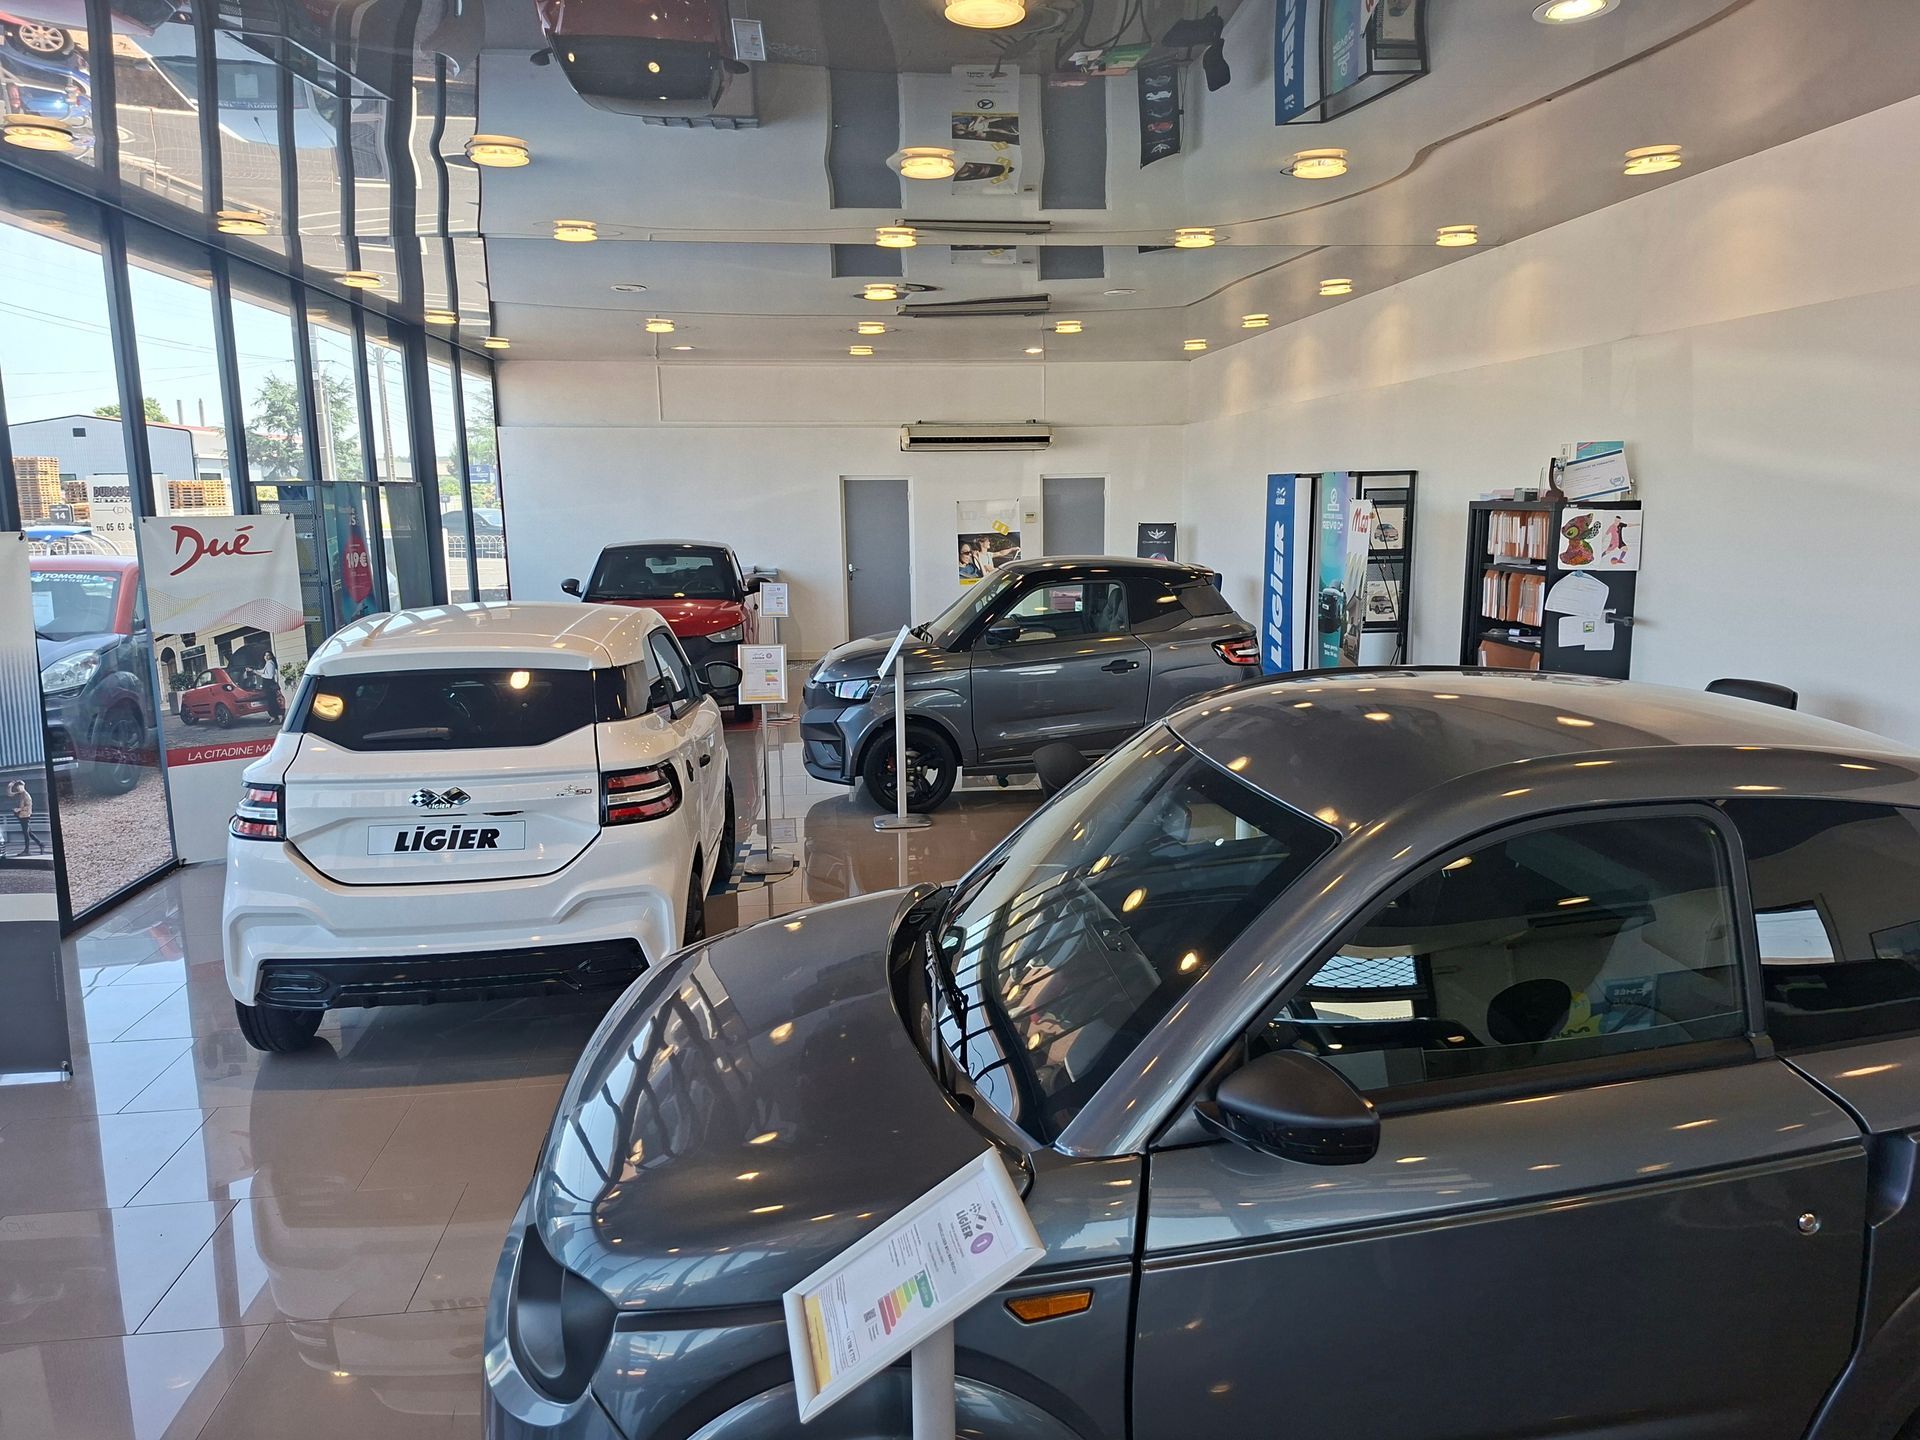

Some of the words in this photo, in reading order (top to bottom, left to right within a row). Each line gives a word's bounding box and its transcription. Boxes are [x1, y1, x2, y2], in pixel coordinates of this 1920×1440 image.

[56, 512, 66, 520] 14
[106, 522, 115, 531] 05
[117, 522, 125, 531] 63
[170, 525, 273, 576] Dué
[33, 572, 100, 581] UTOMOBILE
[187, 752, 203, 762] LA
[204, 745, 254, 760] CITADINE
